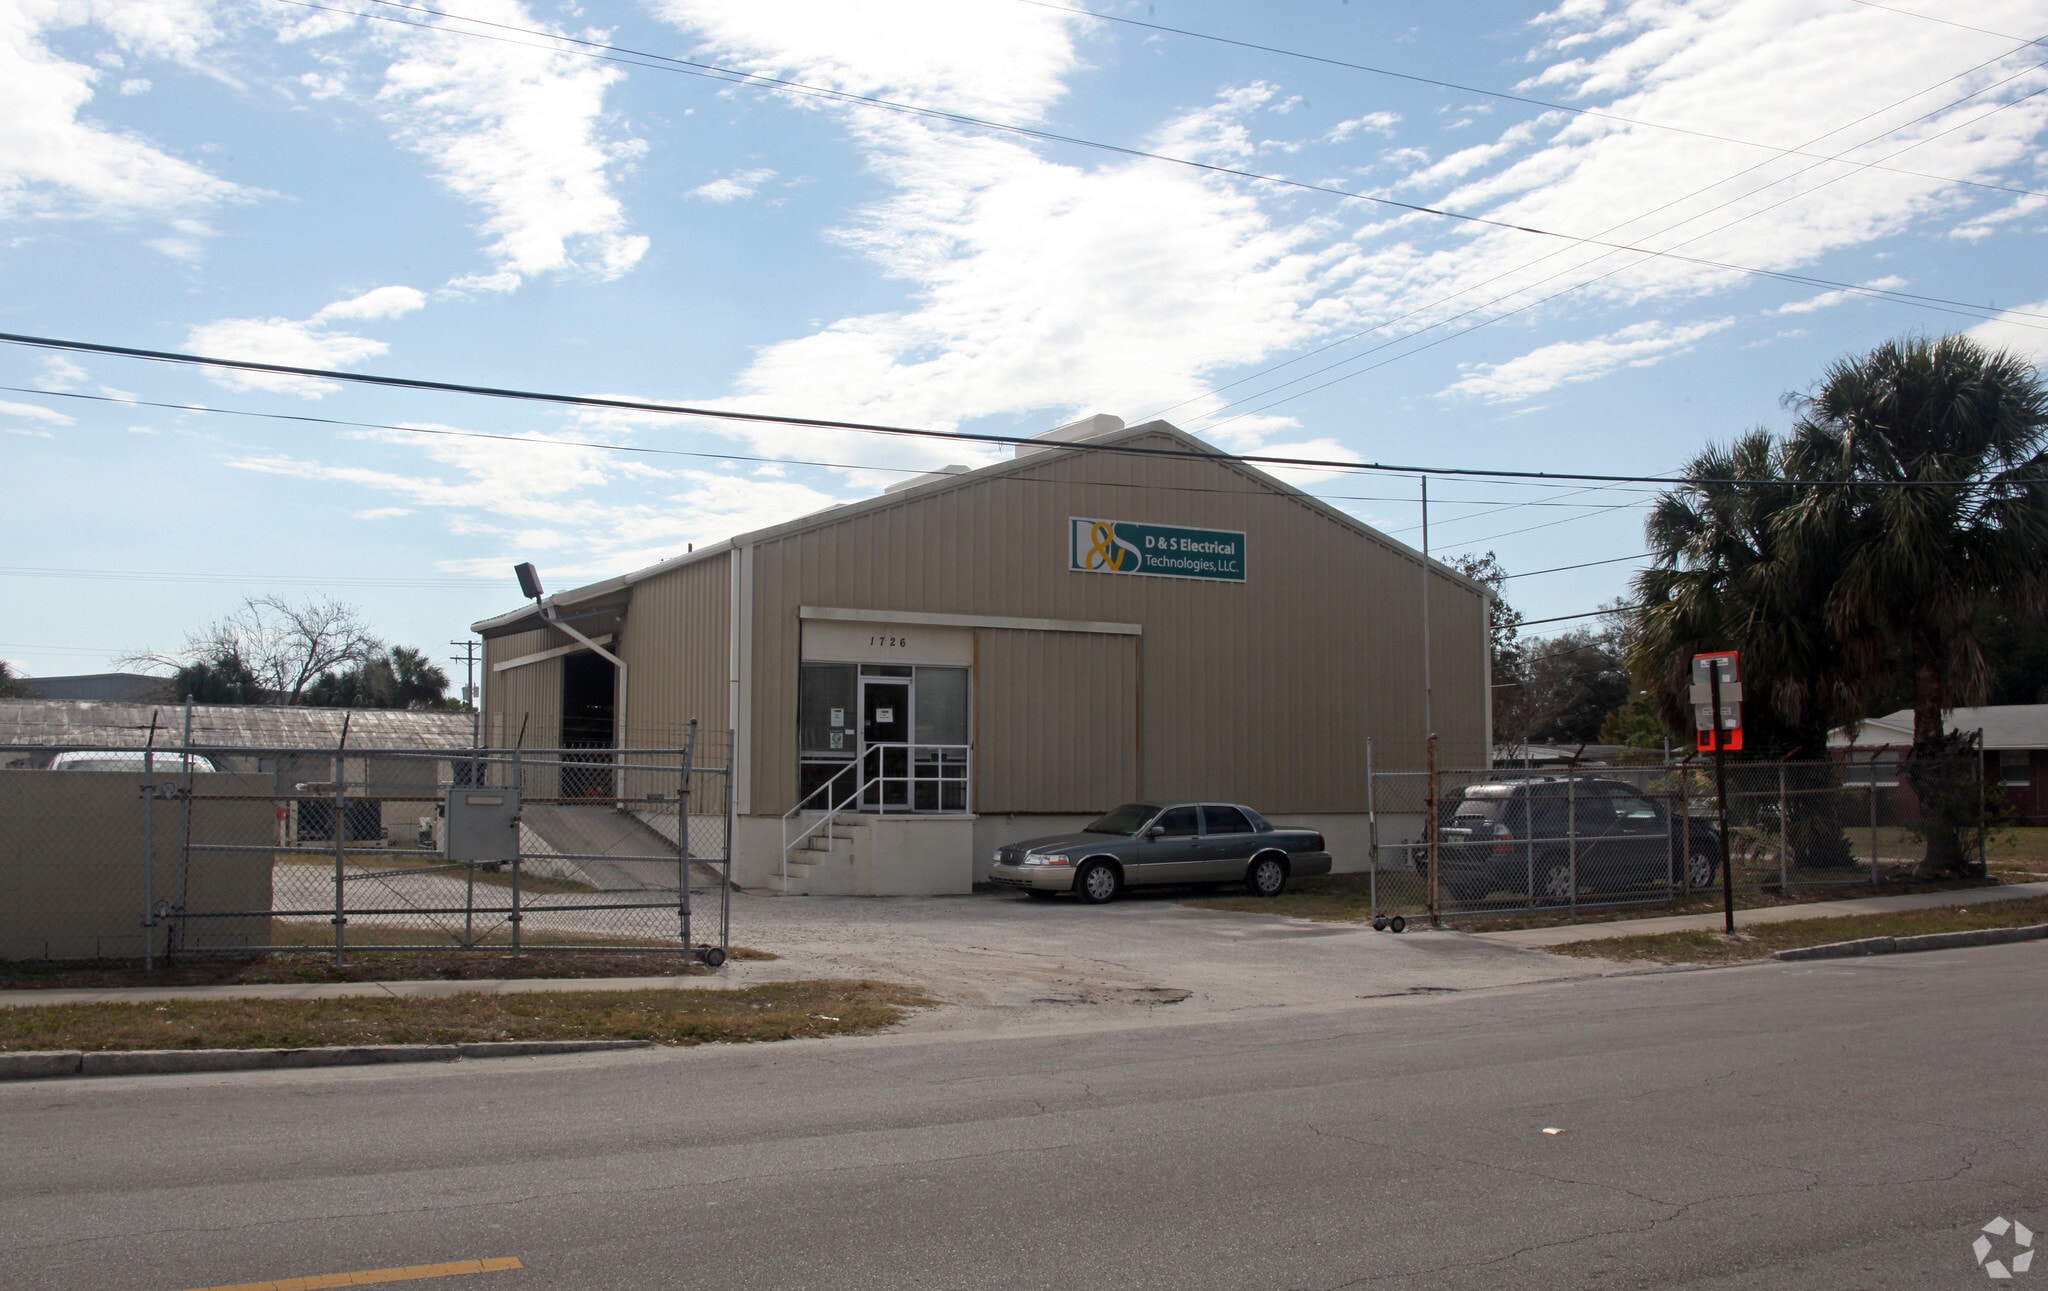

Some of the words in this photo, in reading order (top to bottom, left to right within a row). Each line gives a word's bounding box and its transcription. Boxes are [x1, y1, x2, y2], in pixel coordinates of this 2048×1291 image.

[1145, 535, 1156, 548] D
[1157, 536, 1168, 550] &
[1169, 538, 1178, 551] S
[1180, 538, 1235, 555] Electrical
[1145, 554, 1217, 572] Technologies,
[1218, 560, 1239, 572] LLC.
[870, 636, 906, 648] 1726
